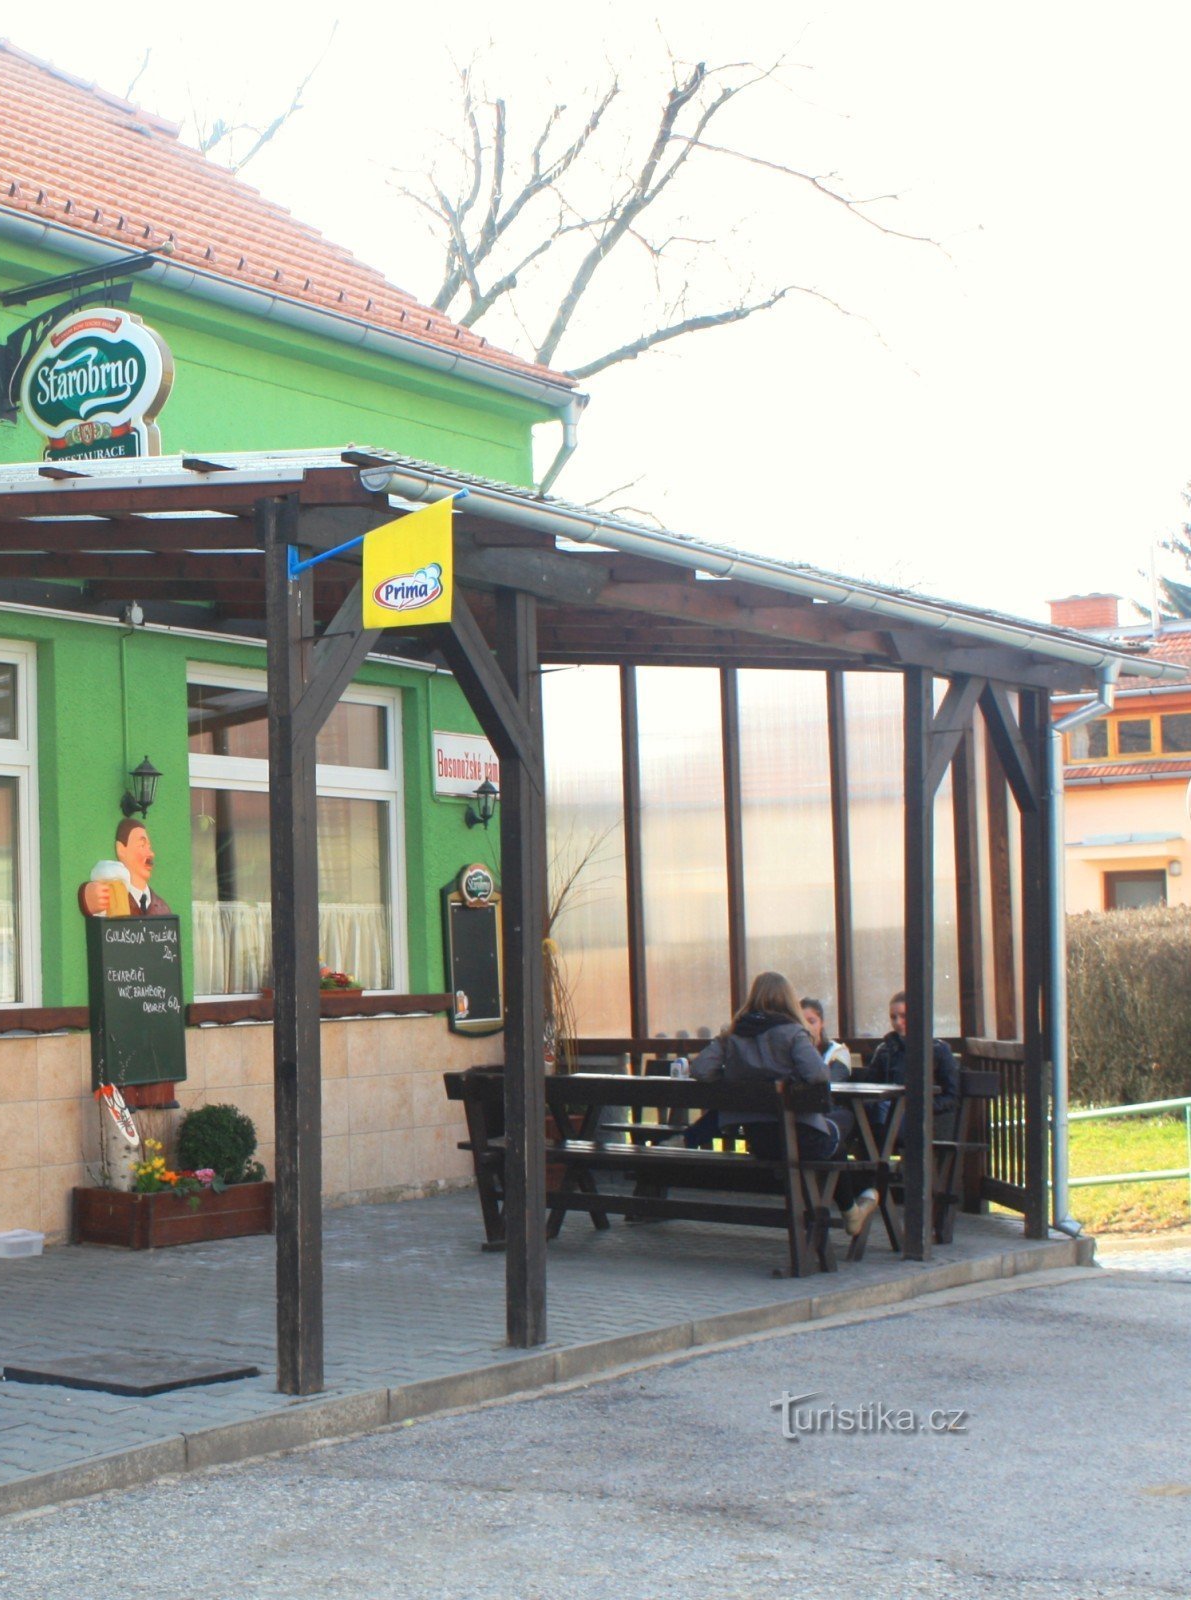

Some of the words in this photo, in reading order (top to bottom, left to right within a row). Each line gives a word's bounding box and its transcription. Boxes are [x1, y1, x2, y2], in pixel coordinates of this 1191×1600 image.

[37, 347, 139, 418] Starobrno
[385, 582, 428, 601] Prima
[437, 748, 482, 781] Bosonožské
